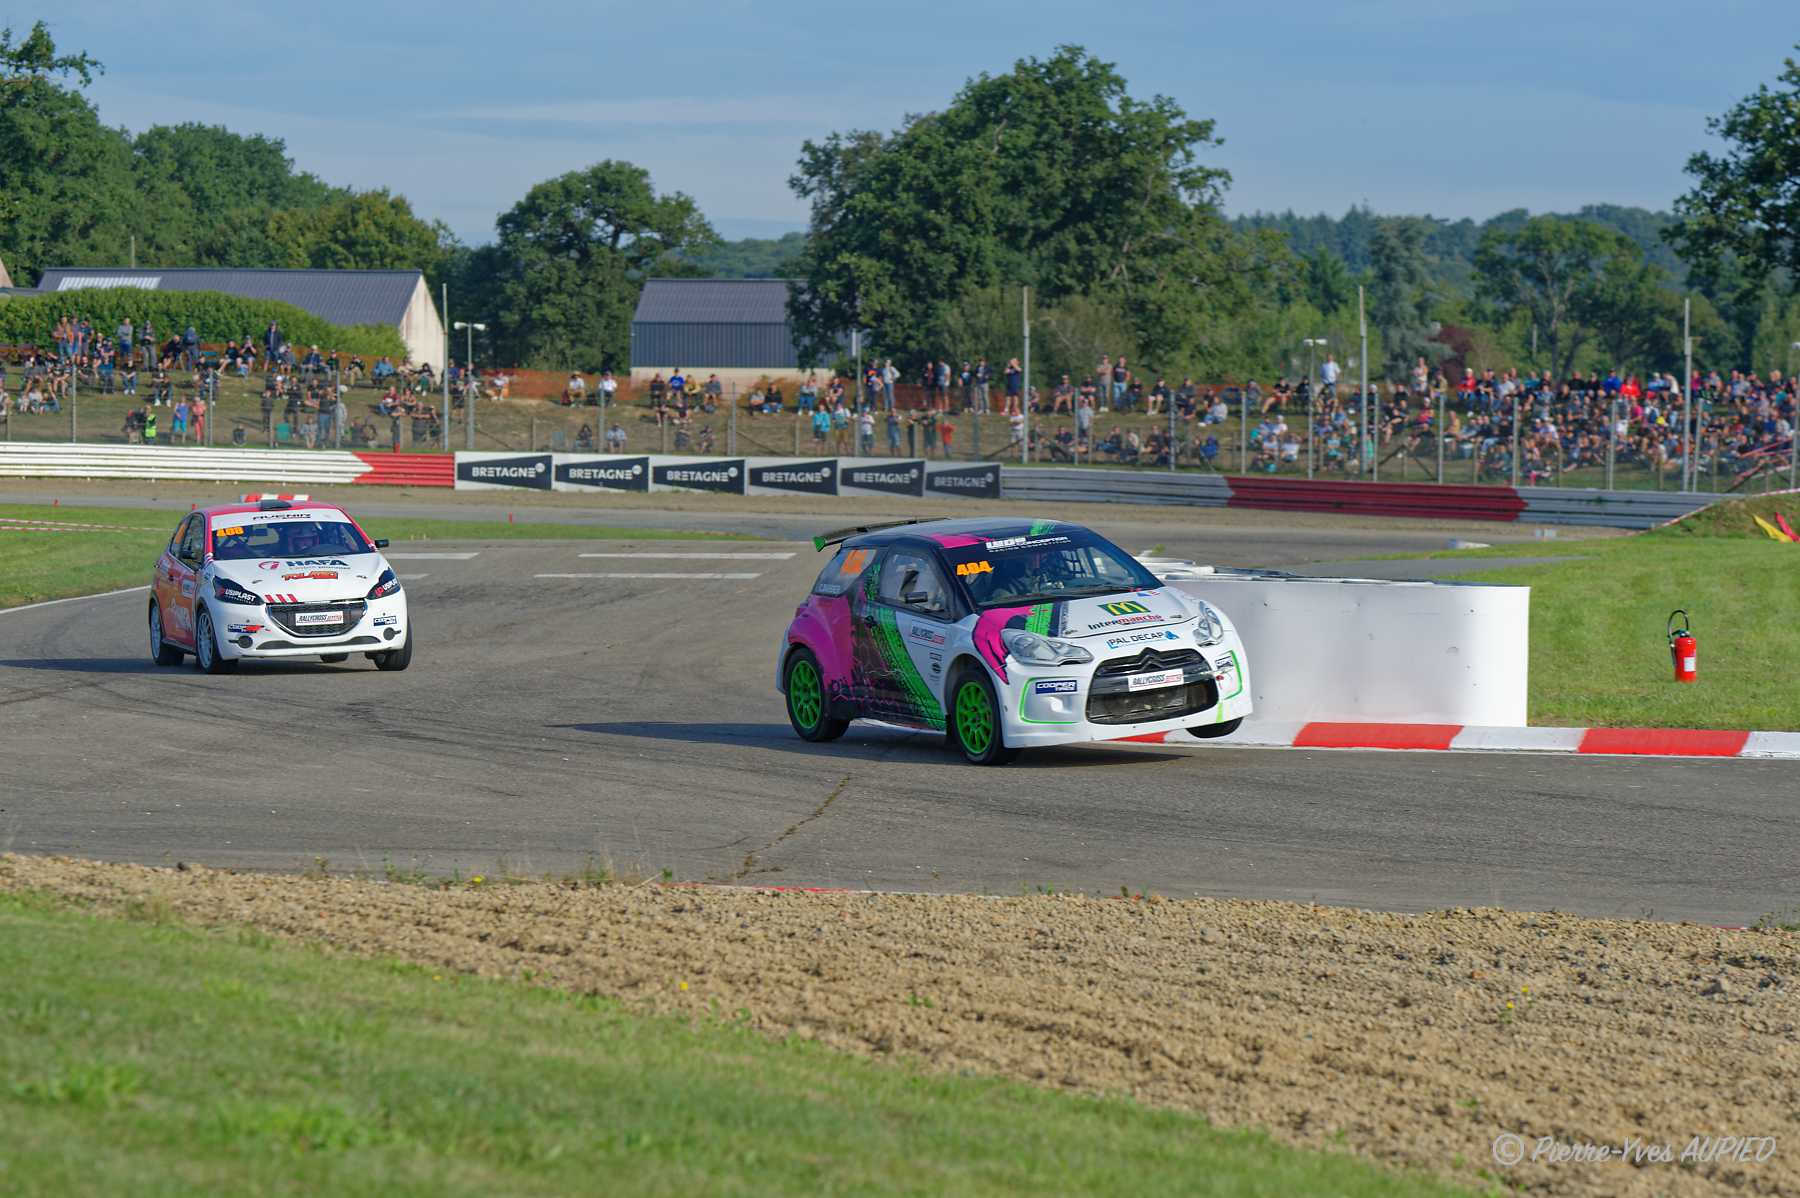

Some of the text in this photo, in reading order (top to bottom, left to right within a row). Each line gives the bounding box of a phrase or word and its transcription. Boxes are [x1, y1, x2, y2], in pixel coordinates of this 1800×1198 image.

[472, 467, 536, 478] BRETAGNE
[569, 468, 633, 480] BRETAGNE
[666, 470, 729, 482] BRETAGNE
[762, 471, 822, 483] BRETAGNE
[853, 472, 911, 484] BRETAGNE
[934, 476, 987, 488] BRETAGNE
[286, 559, 350, 567] HAFA
[1108, 637, 1131, 647] PAL
[1130, 631, 1165, 642] DECAP
[1036, 681, 1076, 689] COOPER
